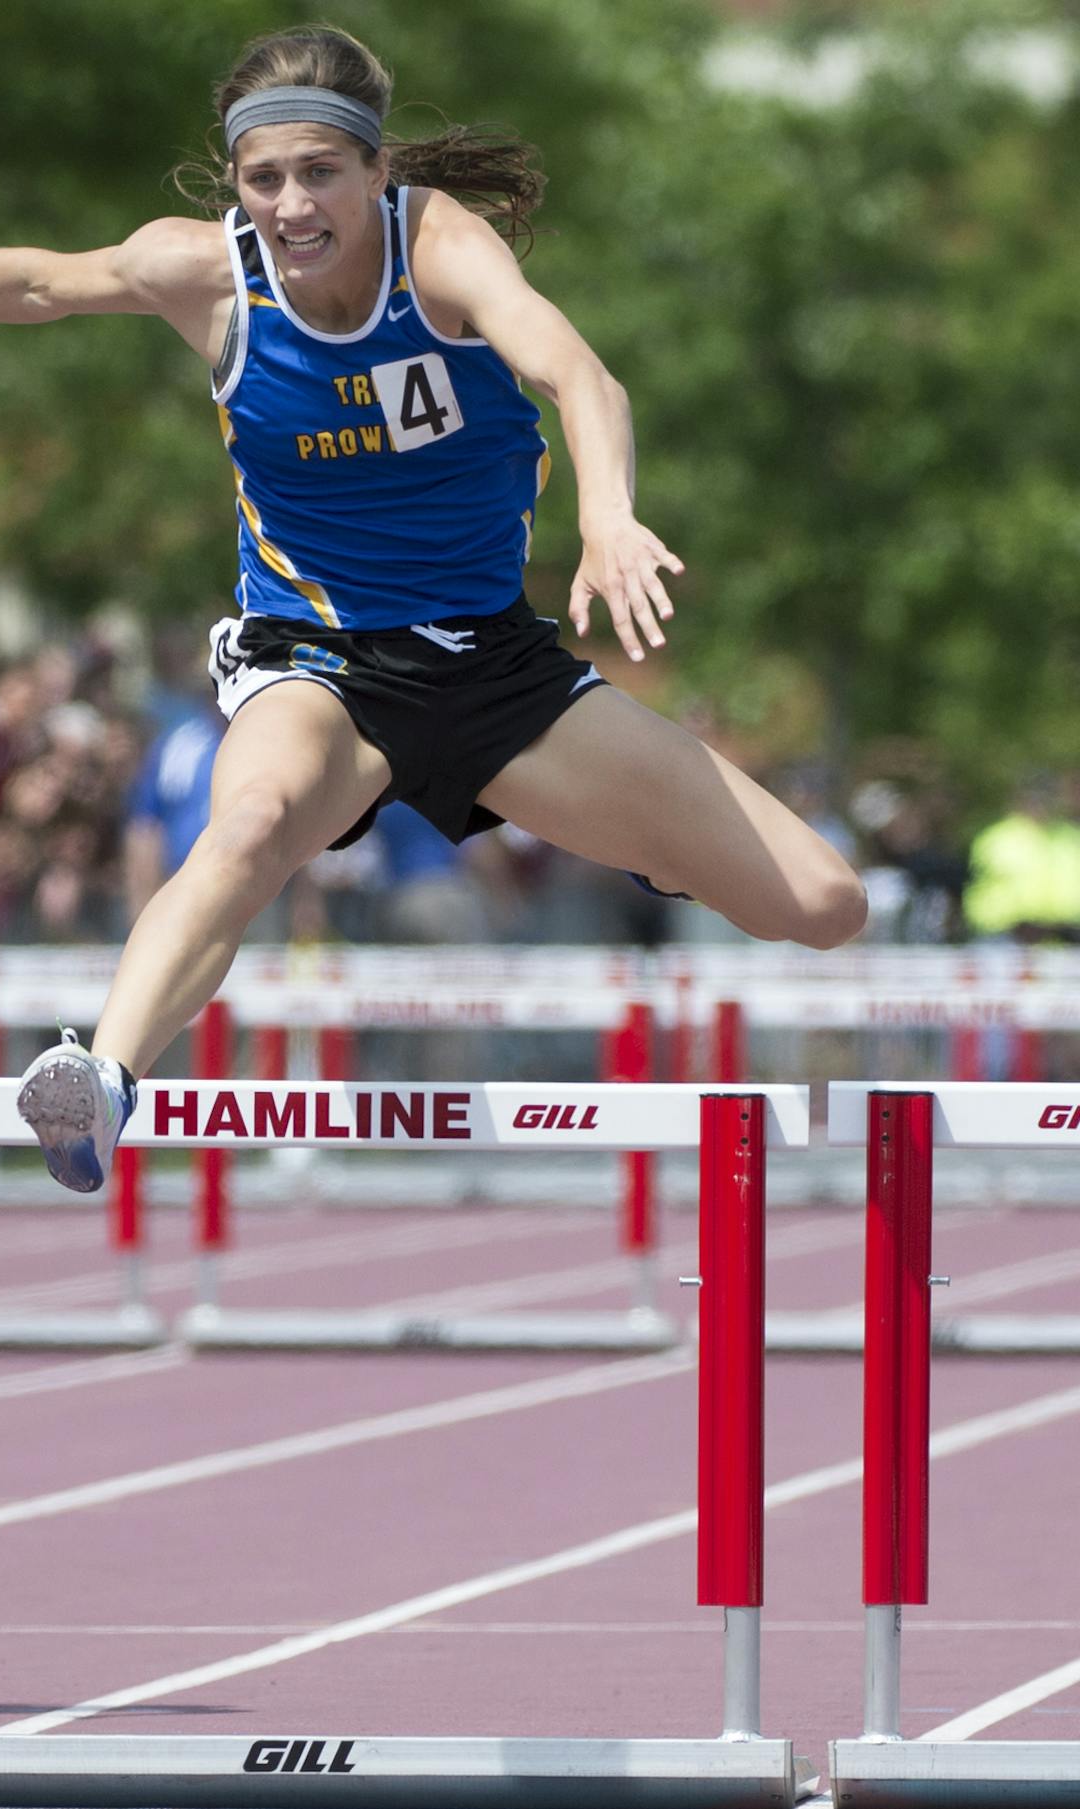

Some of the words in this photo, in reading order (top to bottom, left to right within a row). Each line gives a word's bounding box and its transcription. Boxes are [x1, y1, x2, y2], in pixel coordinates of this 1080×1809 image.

[333, 374, 381, 406] TR
[400, 362, 448, 436] 4
[154, 1090, 471, 1140] HAMLINE
[512, 1104, 599, 1130] GILL
[243, 1739, 356, 1773] GILL
